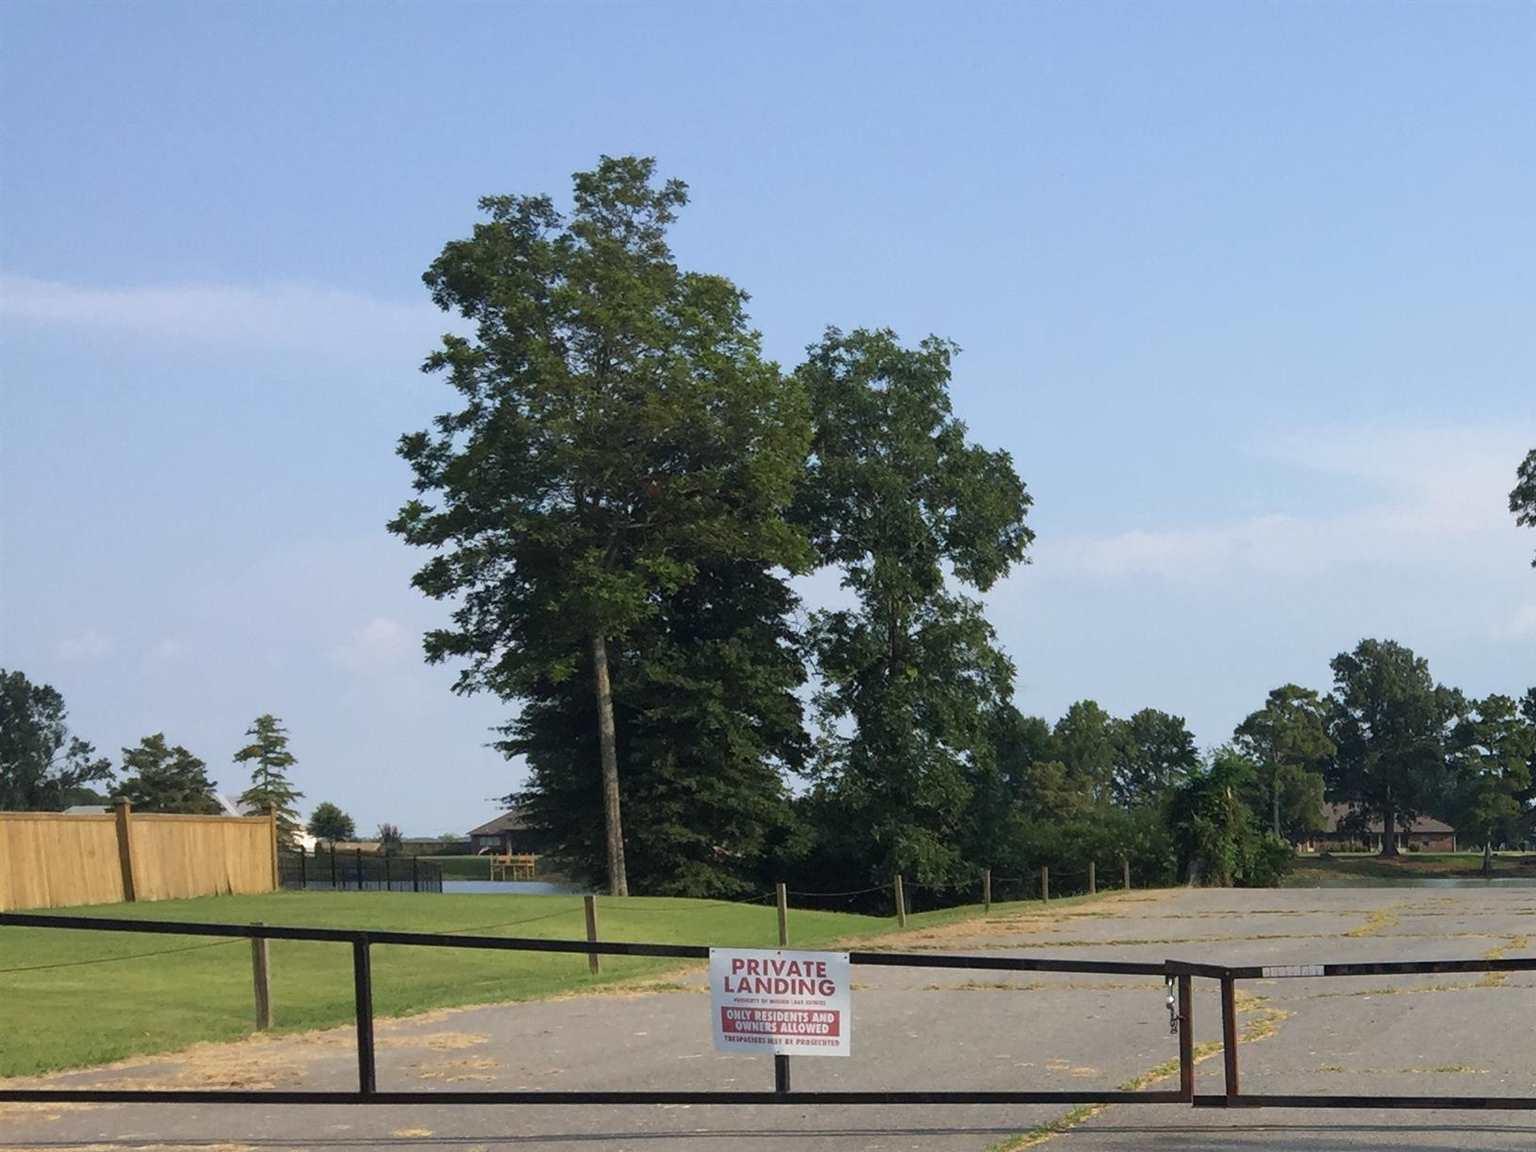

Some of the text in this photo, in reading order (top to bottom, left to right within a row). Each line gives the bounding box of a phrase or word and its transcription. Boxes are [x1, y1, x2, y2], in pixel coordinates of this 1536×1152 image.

[731, 958, 827, 978] PRIVATE
[724, 976, 836, 996] LANDING
[727, 1010, 834, 1024] ONLY RESIDENTS AND
[735, 1021, 829, 1034] OWNERS ALLOWED
